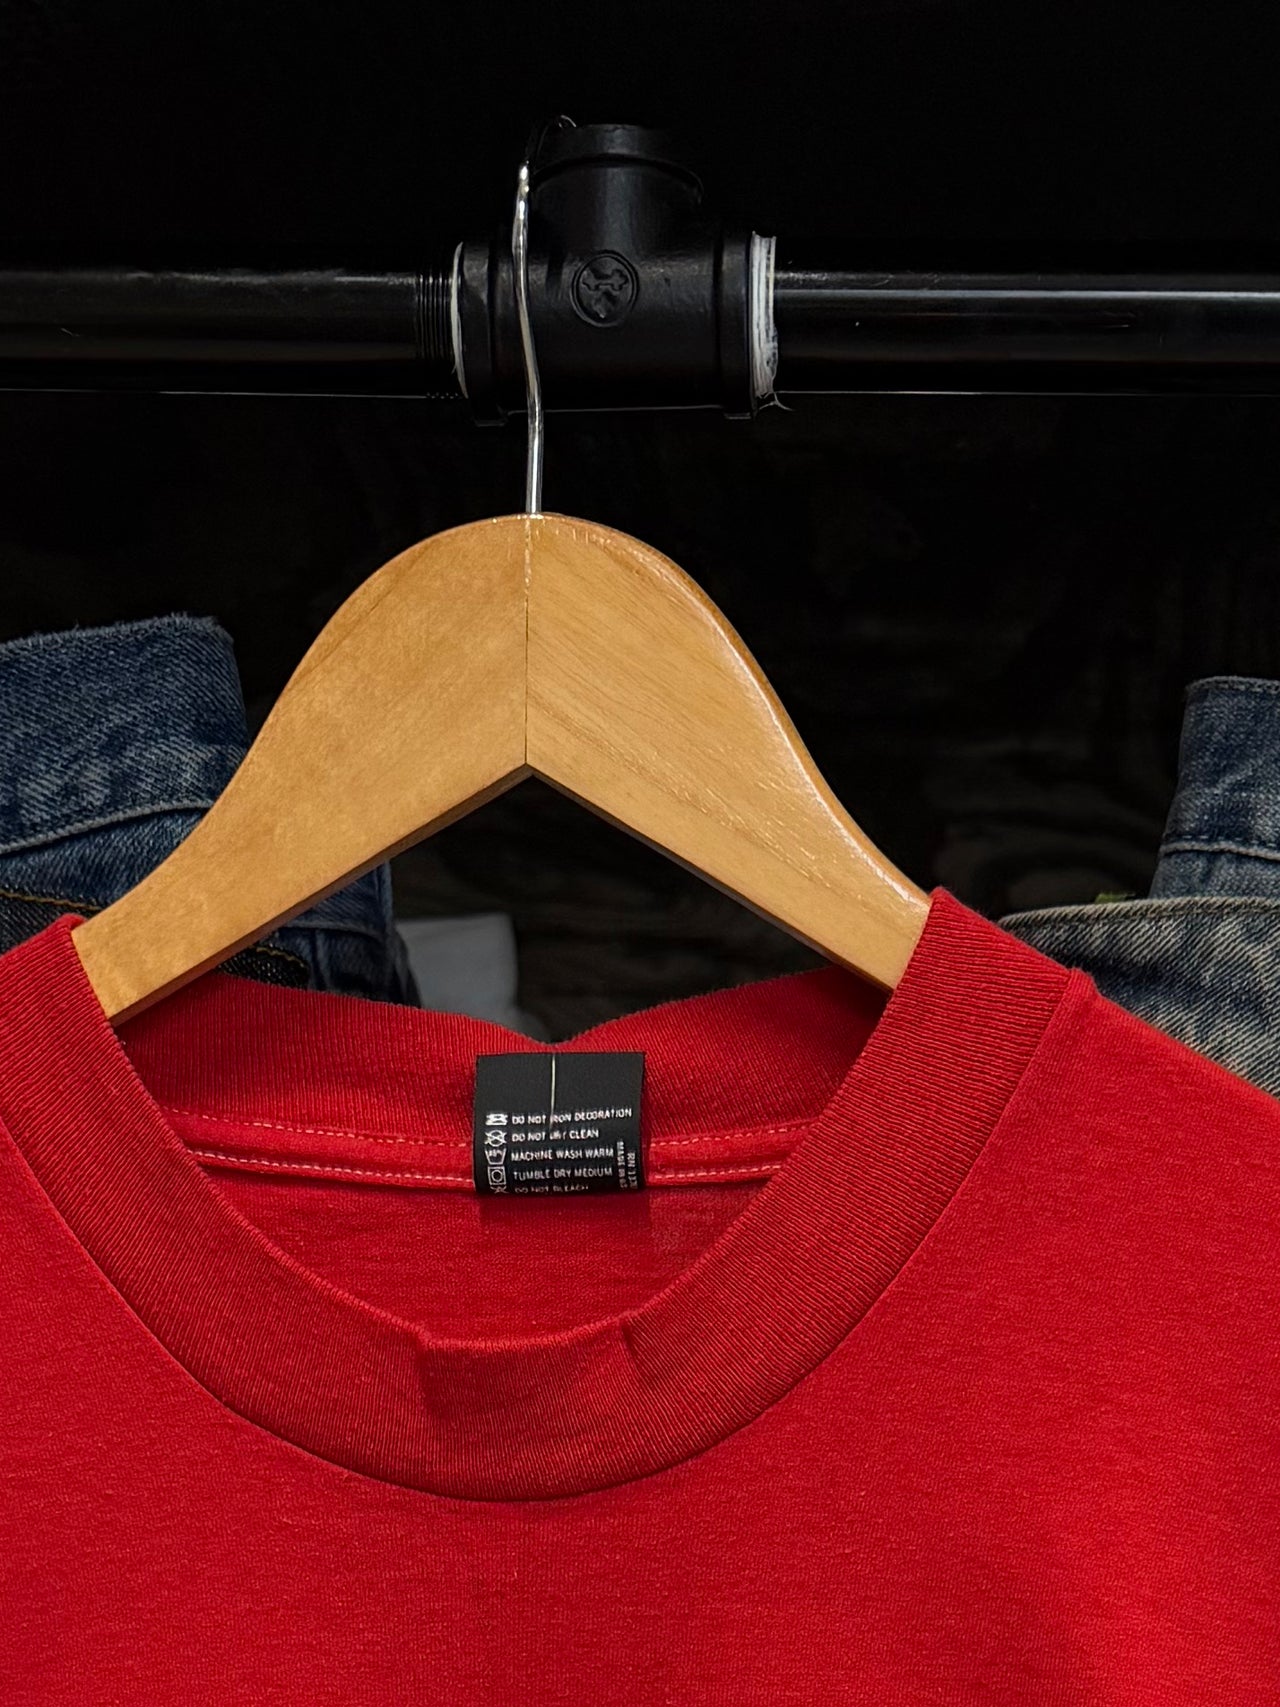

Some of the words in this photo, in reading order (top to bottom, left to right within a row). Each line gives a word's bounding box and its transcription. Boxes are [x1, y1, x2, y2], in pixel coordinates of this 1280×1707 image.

[512, 1115, 525, 1125] DO
[528, 1115, 546, 1124] NOT
[550, 1113, 571, 1124] IRON
[574, 1108, 633, 1121] DECORATION
[512, 1133, 525, 1142] DO
[528, 1132, 546, 1141] NOT
[570, 1129, 599, 1139] CLEAN
[511, 1150, 553, 1162] MACHINE
[556, 1149, 583, 1160] WASH
[585, 1147, 614, 1158] WARM
[513, 1169, 550, 1181] TUMBLE
[554, 1168, 571, 1178] DRY
[574, 1167, 613, 1178] MEDIUM
